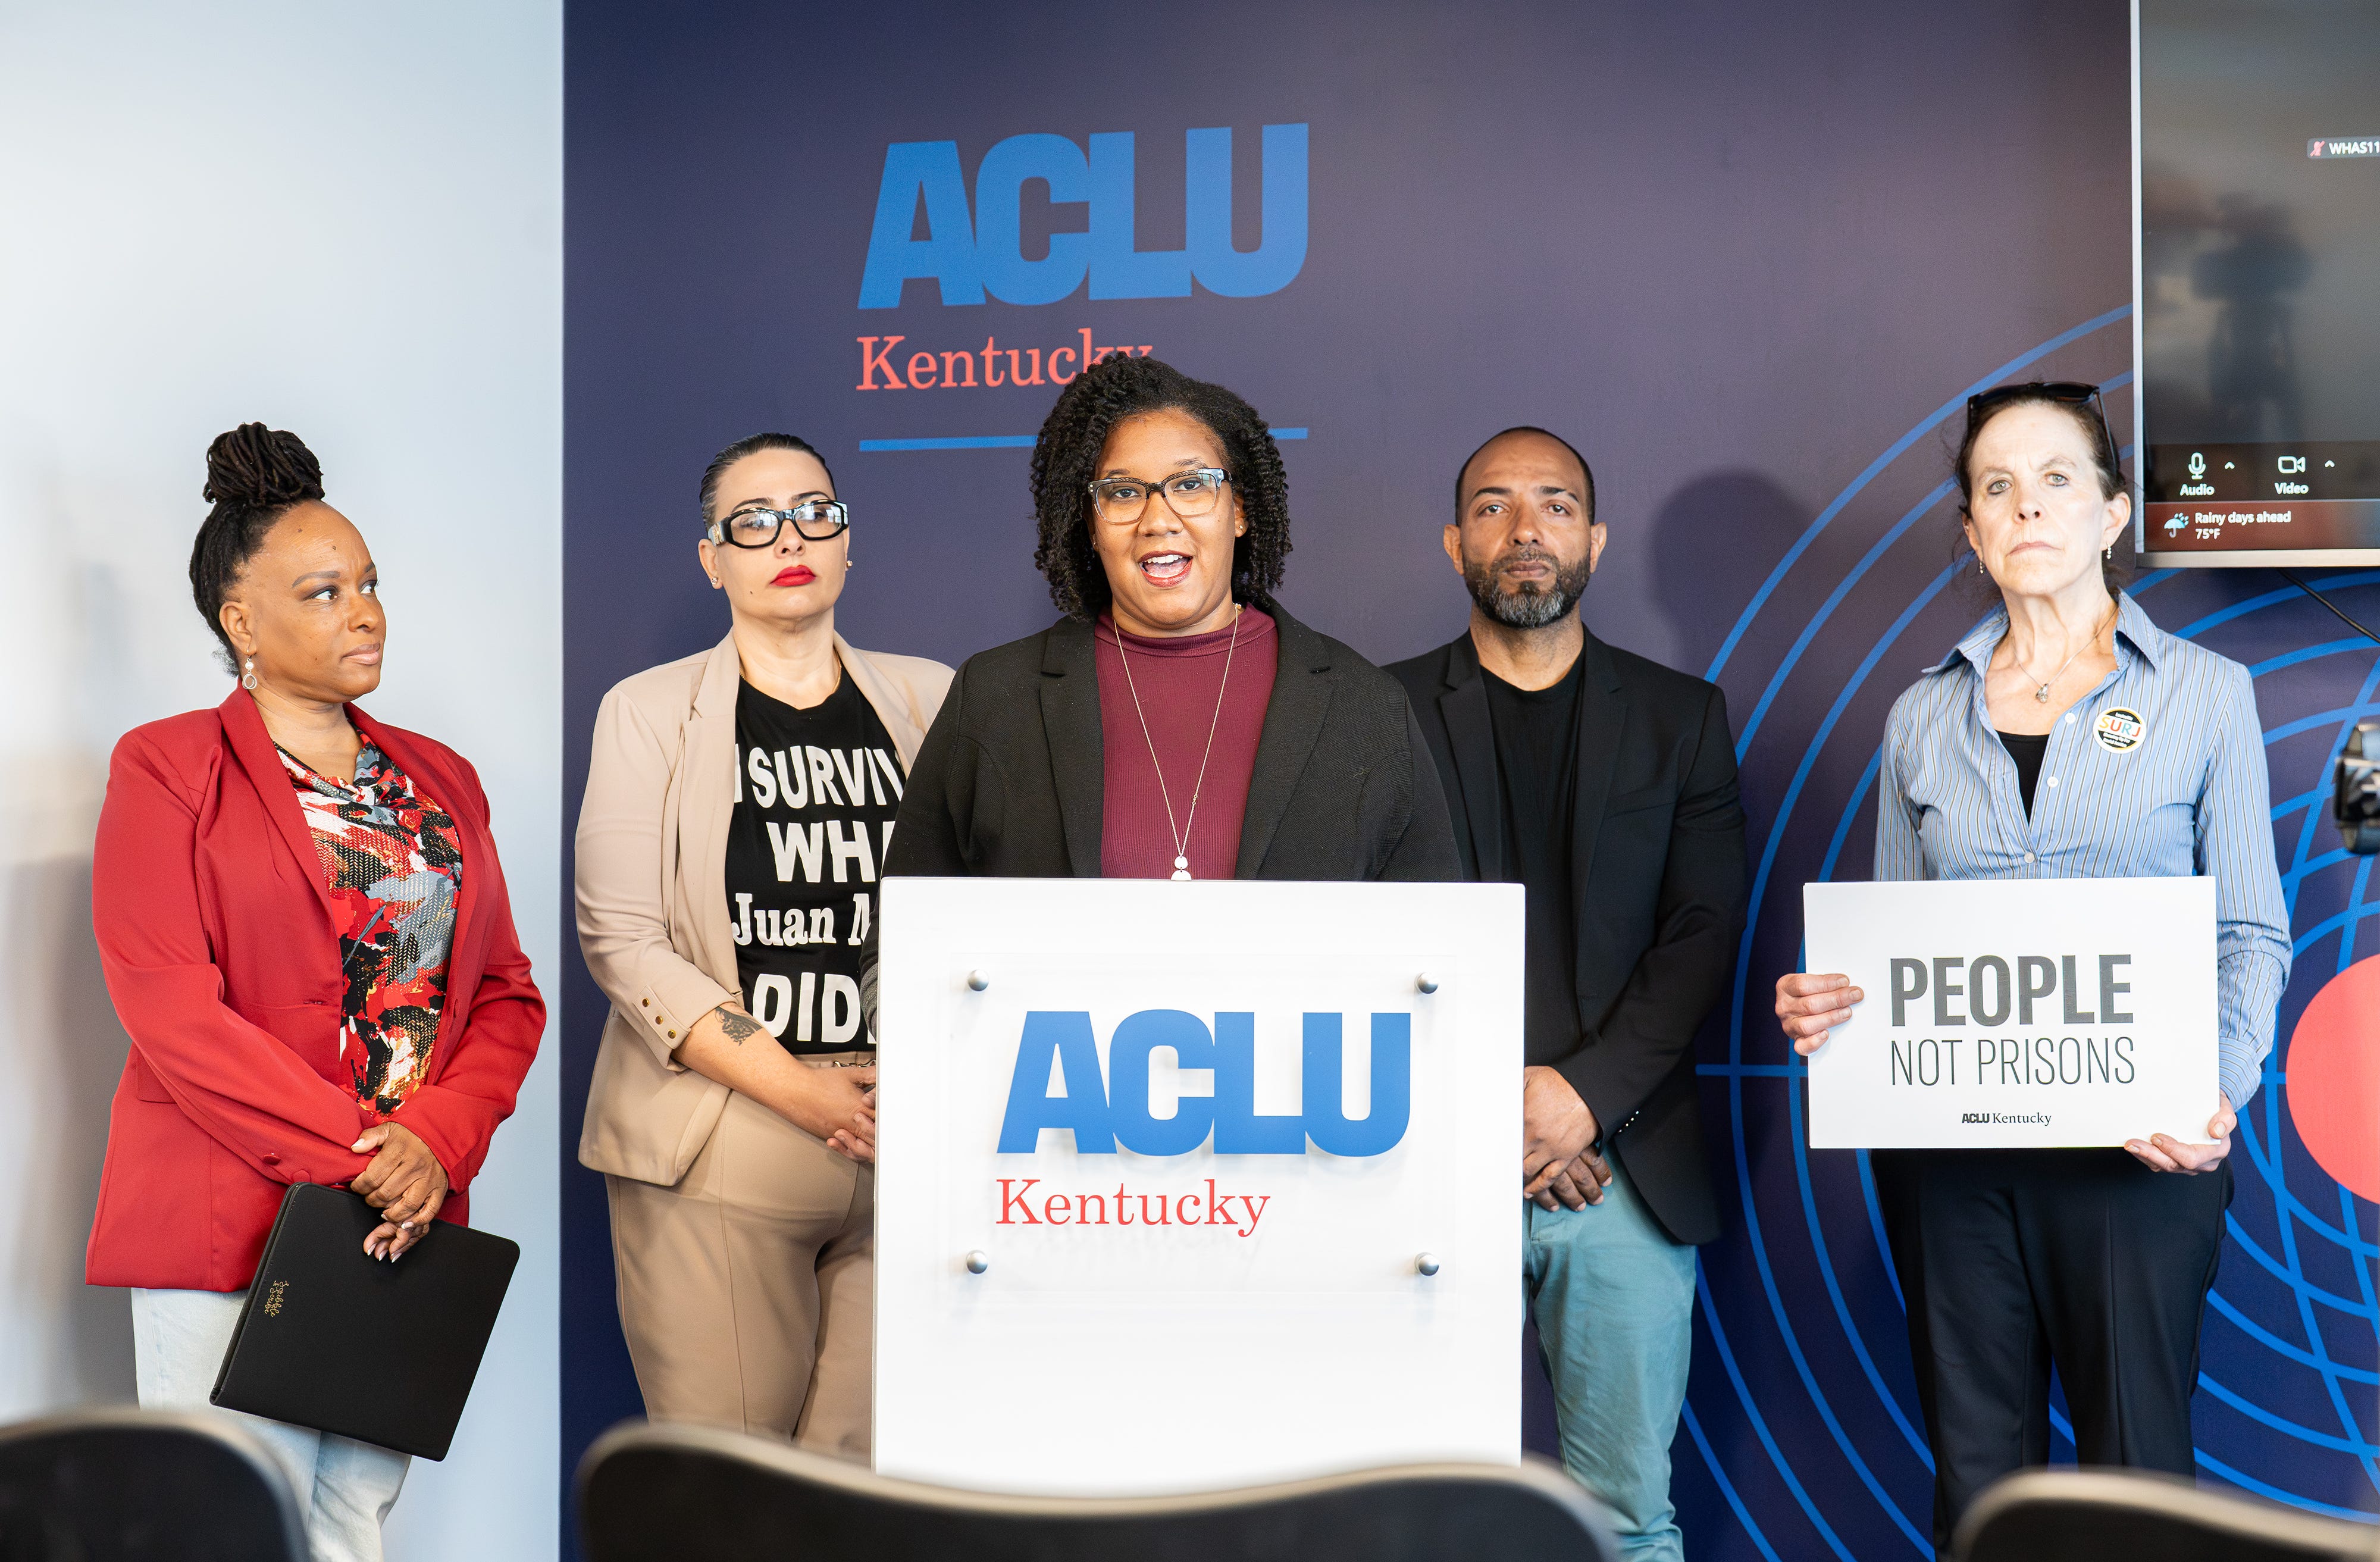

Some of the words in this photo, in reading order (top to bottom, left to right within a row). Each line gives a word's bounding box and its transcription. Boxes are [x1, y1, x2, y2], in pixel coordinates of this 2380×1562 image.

[2328, 140, 2380, 155] WHAS11
[857, 123, 1308, 309] ACLU
[2179, 483, 2215, 496] Audio
[2274, 481, 2309, 494] Video
[2195, 512, 2226, 526] Rainy
[2227, 511, 2254, 526] days
[2256, 510, 2291, 523] ahead
[2195, 528, 2221, 540] 75°F
[2099, 716, 2141, 737] SURJ
[765, 820, 895, 882] WH
[732, 893, 837, 946] Juan
[752, 972, 876, 1044] DID
[1890, 954, 2134, 1026] PEOPLE
[997, 1009, 1411, 1157] ACLU
[1892, 1039, 1963, 1086] NOT
[1978, 1037, 2135, 1085] PRISONS
[1962, 1113, 1990, 1123] ACLU
[1993, 1112, 2052, 1126] Kentucky
[995, 1178, 1271, 1238] Kentucky
